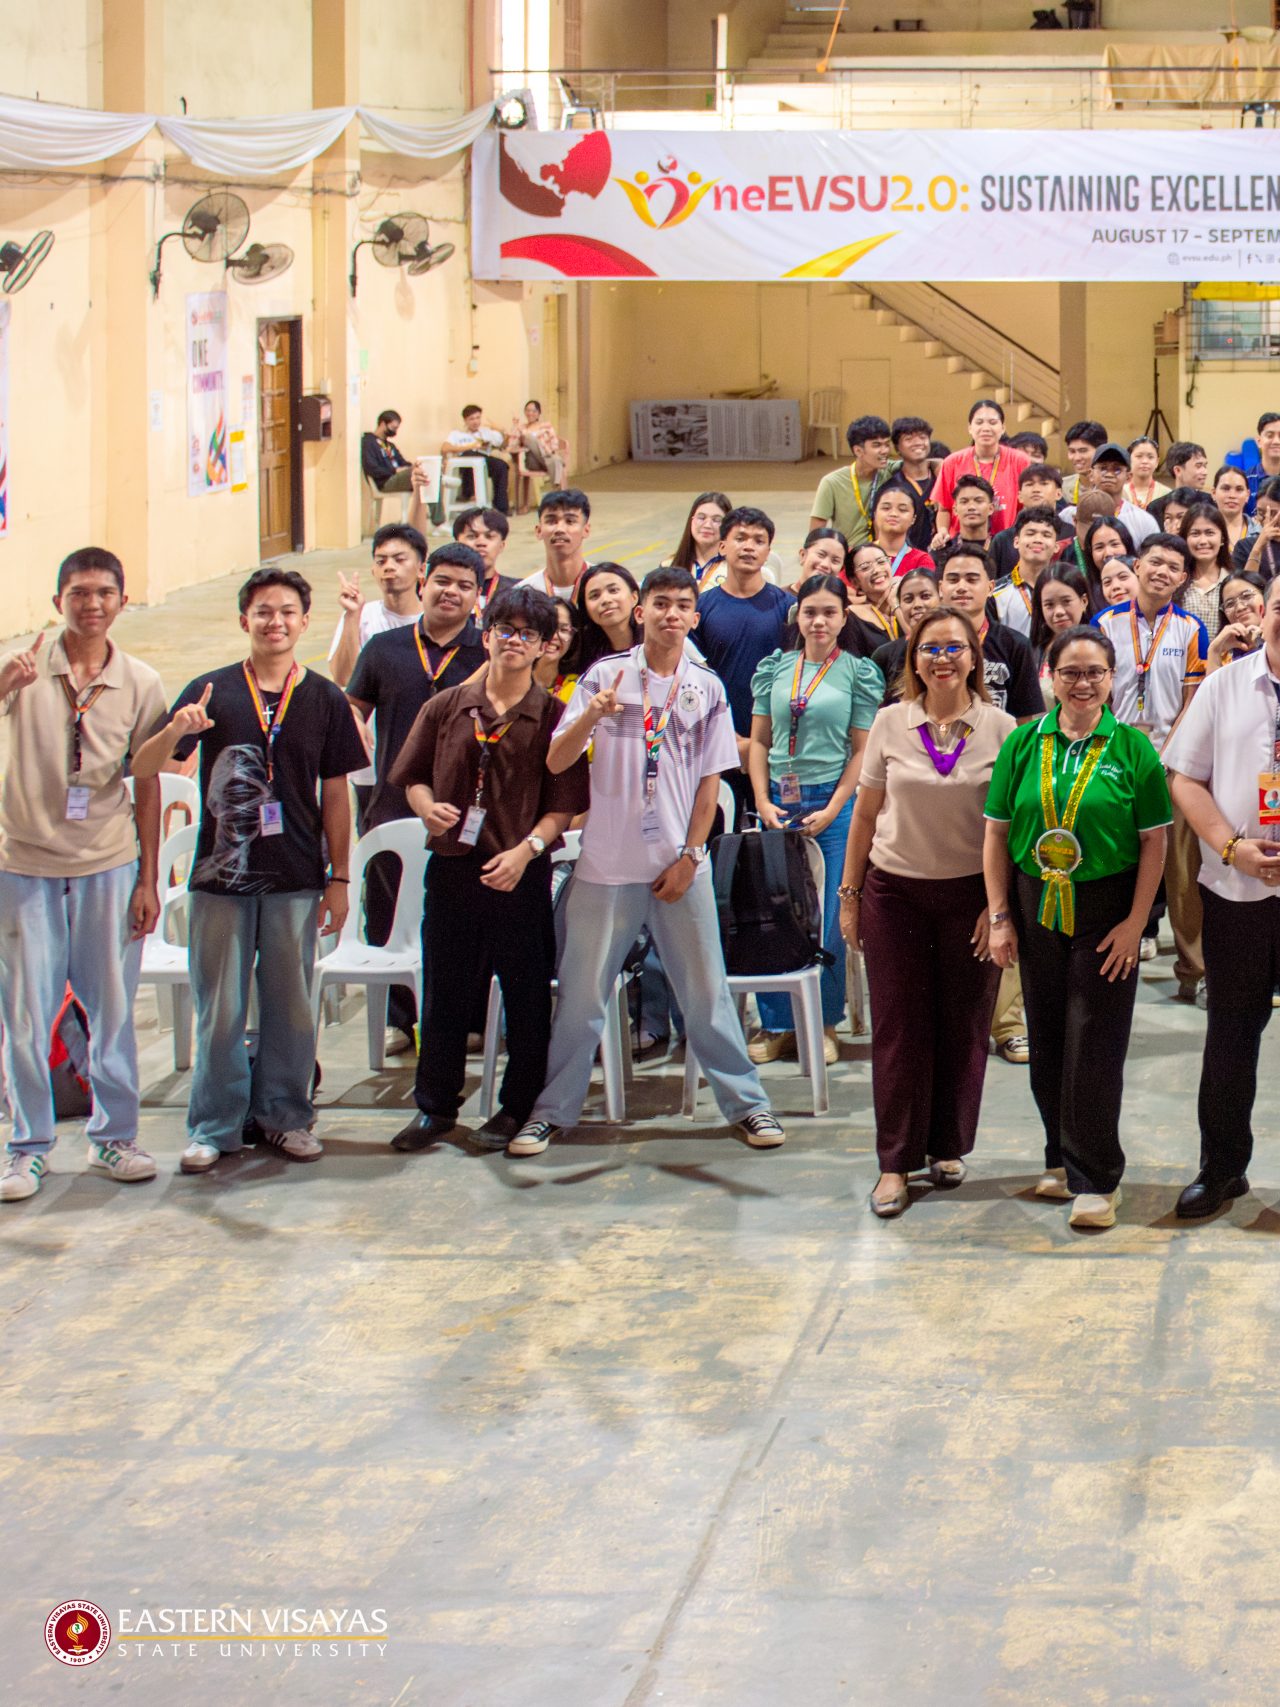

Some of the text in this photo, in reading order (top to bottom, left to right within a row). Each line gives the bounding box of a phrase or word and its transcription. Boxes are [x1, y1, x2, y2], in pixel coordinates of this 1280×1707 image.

[980, 174, 1140, 212] SUSTAINING
[1092, 228, 1166, 244] AUGUST
[1173, 228, 1189, 244] 17
